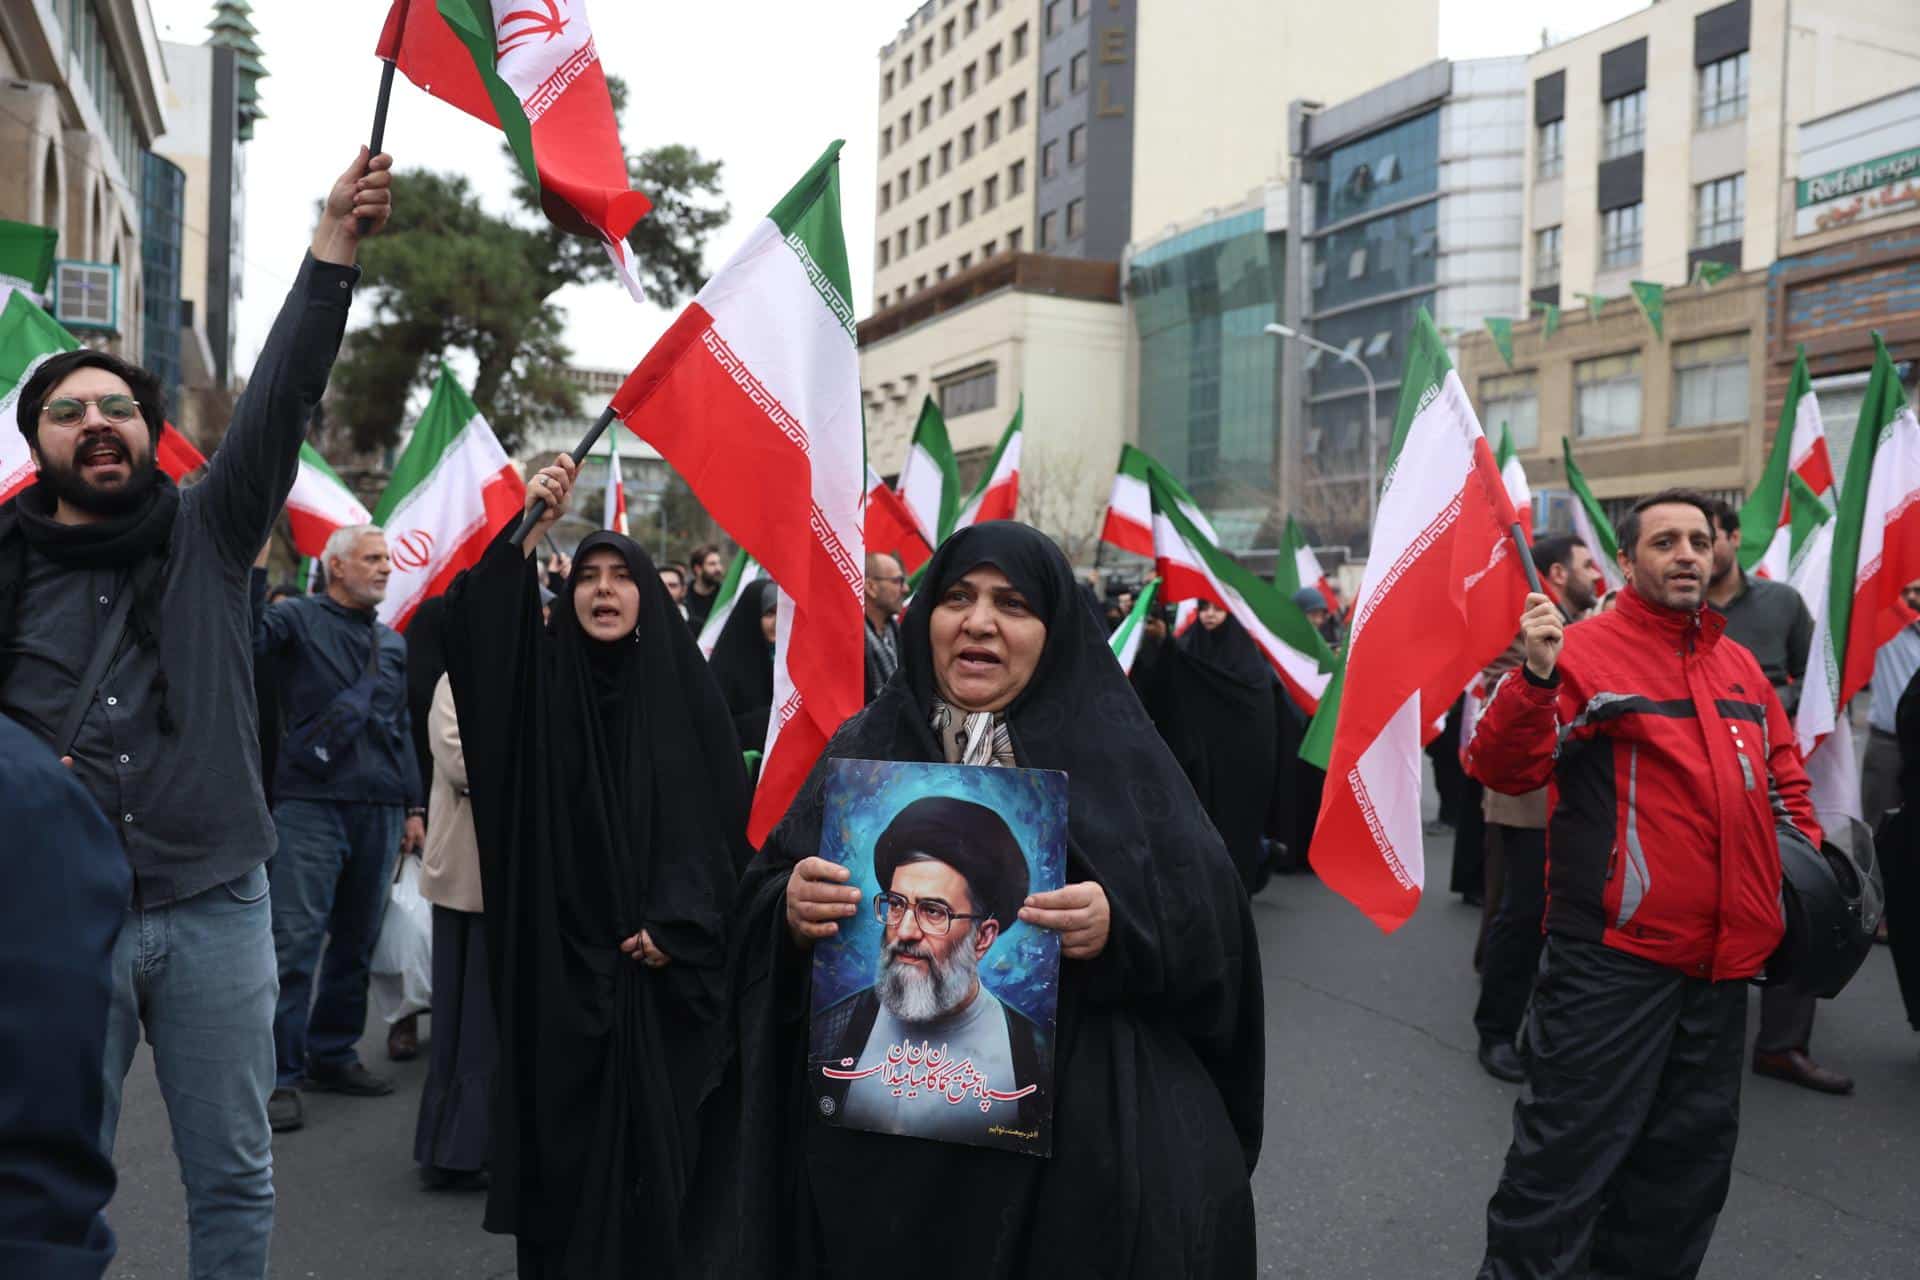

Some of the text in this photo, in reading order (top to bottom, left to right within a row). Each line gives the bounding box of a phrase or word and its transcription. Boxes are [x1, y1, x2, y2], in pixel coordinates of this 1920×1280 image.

[1807, 165, 1873, 202] Refah
[822, 1057, 888, 1084] است
[946, 1063, 982, 1105] عشق
[973, 1074, 1038, 1113] سپاه
